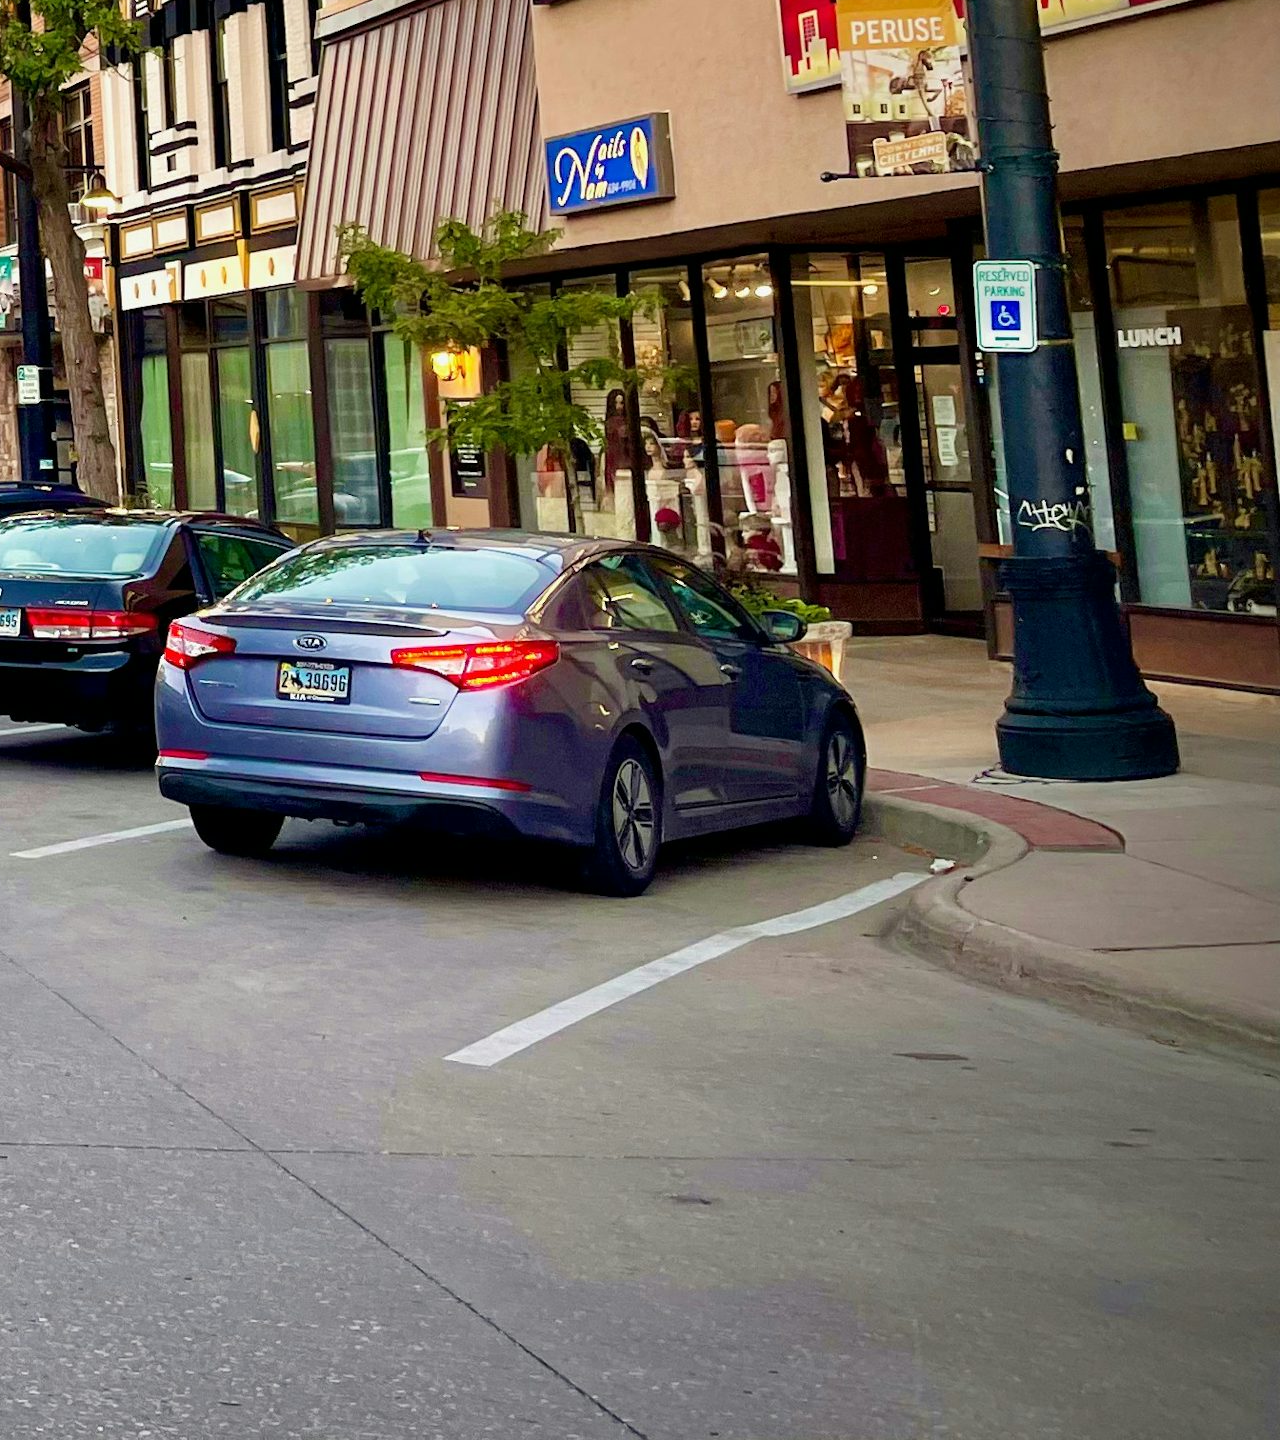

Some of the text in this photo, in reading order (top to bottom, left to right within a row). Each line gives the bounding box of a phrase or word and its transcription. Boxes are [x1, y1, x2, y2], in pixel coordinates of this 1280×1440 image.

[851, 17, 945, 45] PERUSE
[878, 136, 944, 155] DOWNTOWN
[879, 143, 944, 166] CHEYENNE
[555, 131, 626, 207] Nails
[979, 269, 1030, 282] RESERVED
[984, 285, 1025, 297] PARKING
[1117, 326, 1182, 348] LUNCH
[300, 638, 320, 647] KIA
[281, 670, 346, 692] 2 39696
